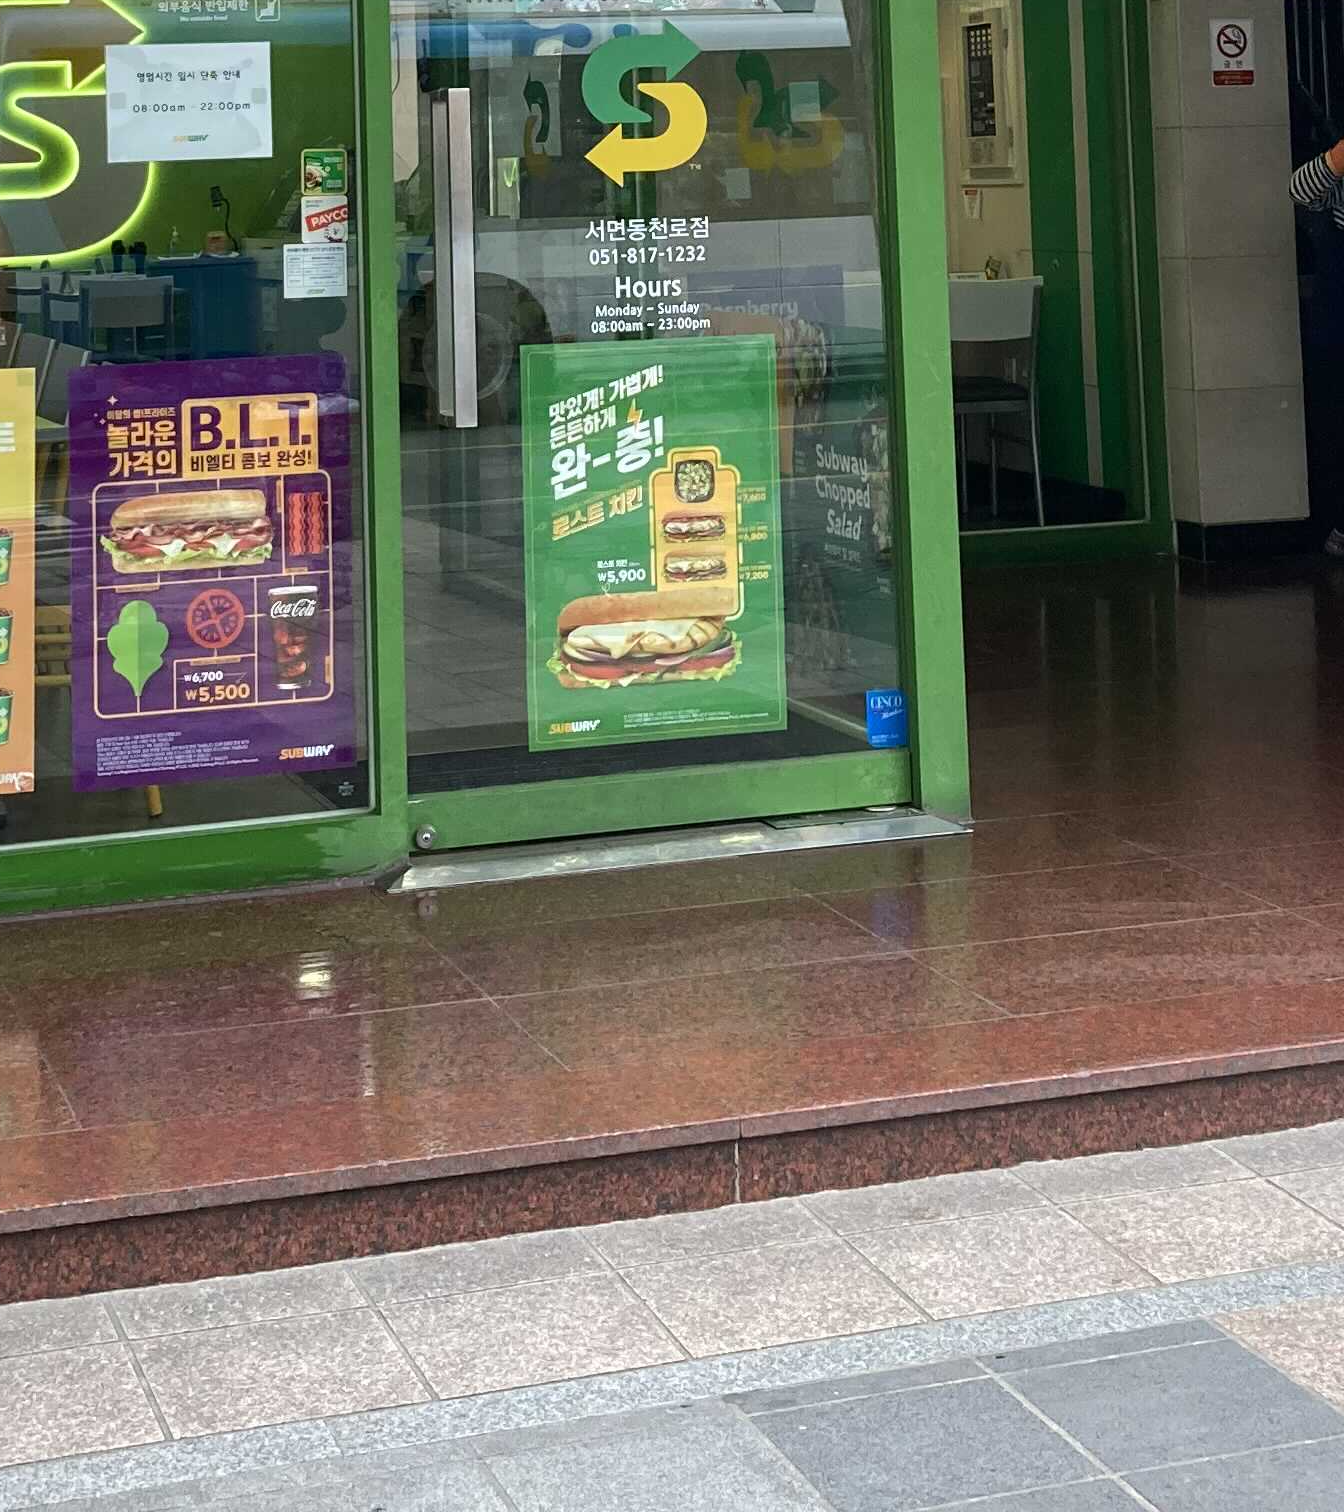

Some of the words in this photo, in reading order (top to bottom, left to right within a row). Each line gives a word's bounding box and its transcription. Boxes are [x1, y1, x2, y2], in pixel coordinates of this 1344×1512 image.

[136, 71, 173, 82] 영업시간
[132, 103, 186, 113] 08:00am
[199, 101, 251, 111] 22:00pm
[585, 216, 710, 242] 서면동천로점
[589, 245, 706, 265] 051-817-1232
[615, 275, 682, 299] Hours
[595, 304, 643, 318] Monday
[657, 301, 699, 316] Sunday
[591, 320, 644, 334] 08:00am
[658, 317, 711, 331] 23:00pm
[549, 387, 605, 425] 맛있게!
[608, 364, 664, 402] 가볍게!
[107, 420, 176, 449] 놀라운
[190, 399, 311, 452] B.L.T.
[550, 405, 616, 450] 든든하게
[108, 449, 177, 478] 가격의
[191, 453, 236, 473] 비엘티
[241, 452, 272, 470] 콤보
[276, 450, 312, 468] 완성!
[815, 443, 868, 483] Subway
[815, 475, 871, 510] Chopped
[826, 509, 863, 541] Salad
[549, 719, 600, 735] SUBWAY
[279, 744, 335, 761] SUBWAY
